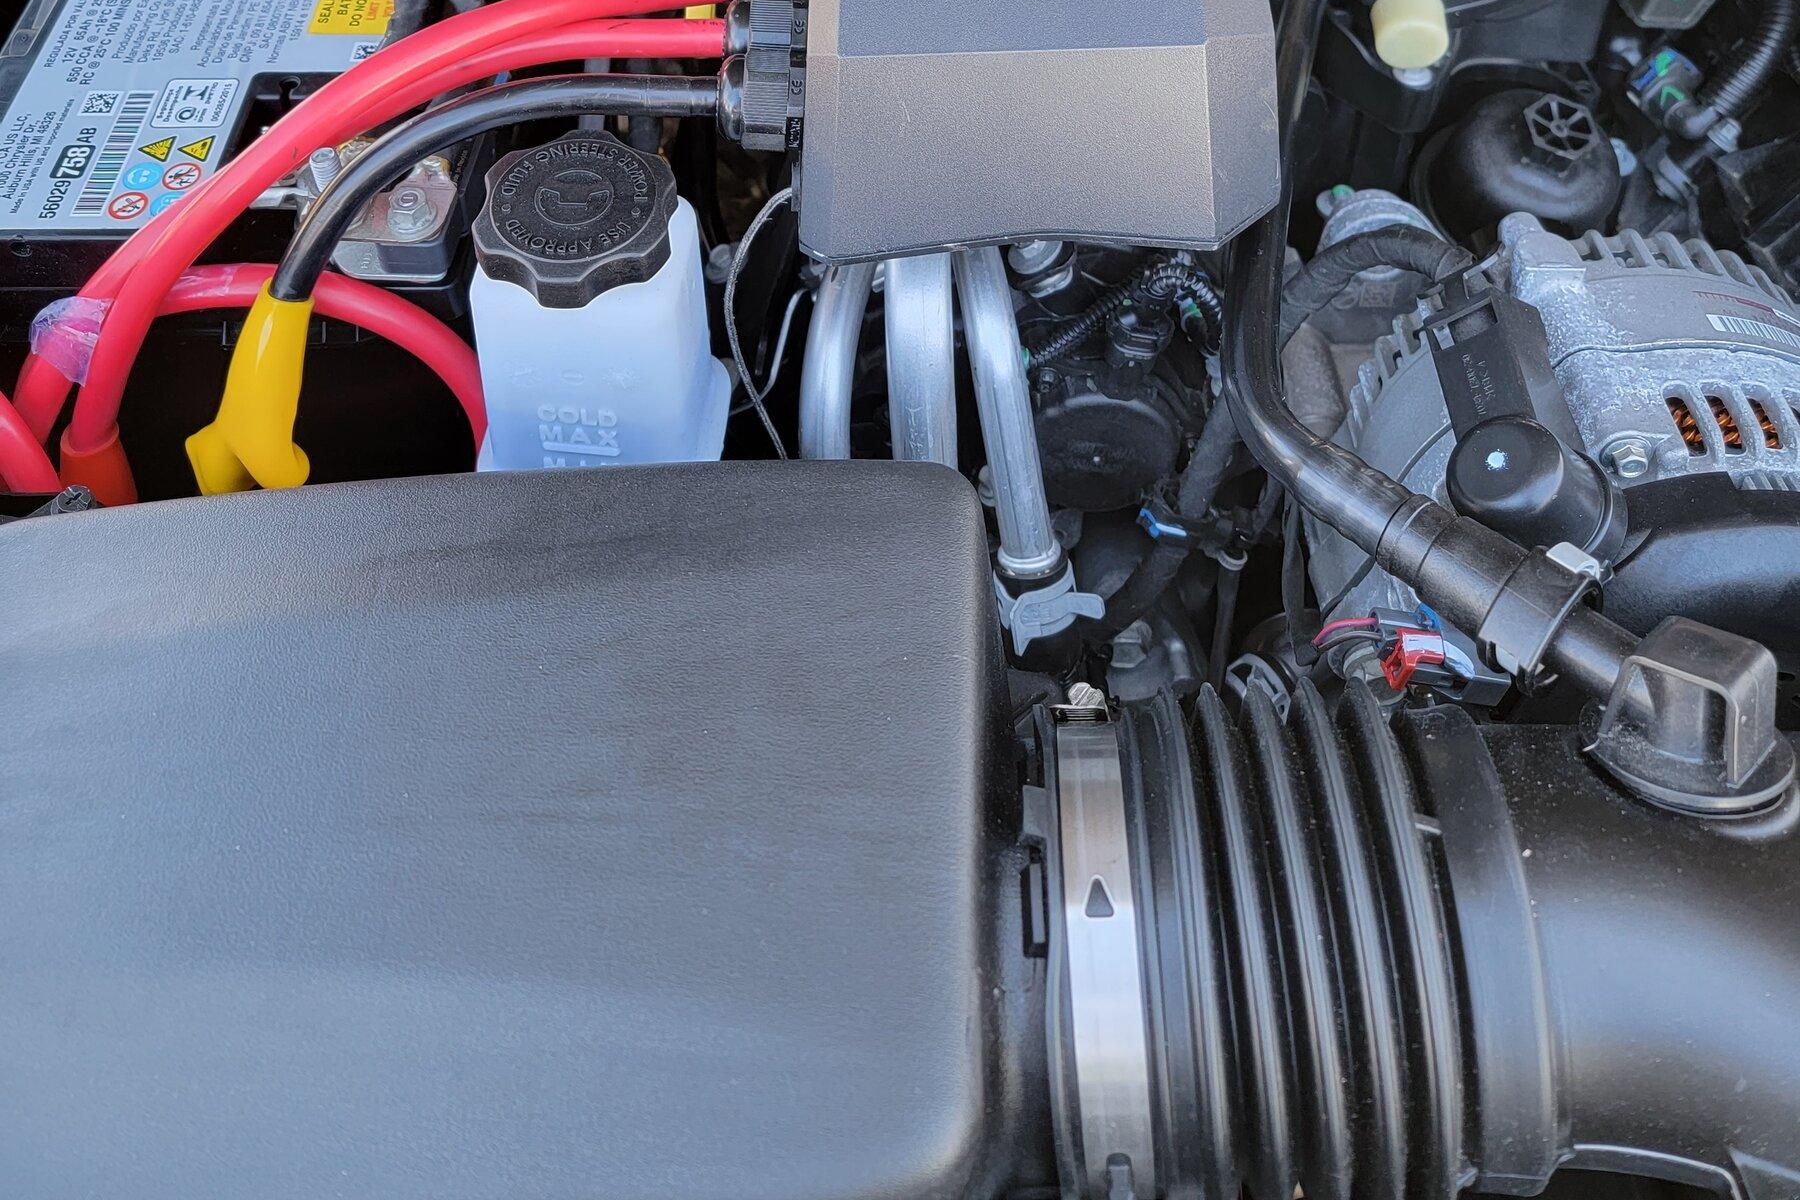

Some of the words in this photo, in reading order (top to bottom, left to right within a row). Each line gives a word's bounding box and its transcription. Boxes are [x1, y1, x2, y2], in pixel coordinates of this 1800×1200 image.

[44, 30, 71, 68] REGULADA
[65, 15, 79, 29] POR
[62, 47, 78, 63] 12V
[74, 19, 93, 40] 65Ah
[111, 23, 138, 59] Produzido
[132, 10, 143, 22] por
[123, 13, 158, 63] Manufacturing
[137, 44, 155, 62] Deka
[156, 9, 170, 25] Lyon
[163, 3, 188, 37] Produzido
[259, 32, 274, 49] SAC
[266, 35, 286, 64] Normas
[279, 13, 294, 33] ABNT
[349, 14, 362, 26] DO
[66, 67, 83, 82] 650
[76, 45, 94, 65] CCA
[87, 35, 99, 43] @
[79, 72, 95, 85] RC
[88, 61, 100, 69] @
[105, 22, 120, 36] 100
[791, 79, 803, 96] CE
[3, 133, 18, 145] US
[11, 114, 31, 132] LLC,
[5, 135, 30, 169] Chrysler
[23, 120, 39, 133] Dr.,
[536, 141, 618, 163] STEERING
[2, 169, 26, 199] Auburn
[18, 147, 40, 167] Hills,
[30, 136, 43, 145] MI
[37, 112, 56, 134] 48326
[10, 198, 24, 214] Made
[22, 179, 34, 191] USA
[30, 167, 40, 178] with
[35, 158, 45, 166] US
[41, 147, 51, 156] and
[59, 99, 75, 122] materials
[39, 180, 71, 219] 56029
[57, 147, 90, 176] 758
[77, 128, 97, 143] AB
[501, 160, 534, 196] FLUID
[618, 154, 648, 202] POWER
[506, 219, 592, 256] APPROVED
[599, 220, 632, 246] USE
[538, 404, 617, 428] COLD
[539, 424, 618, 448] MAX
